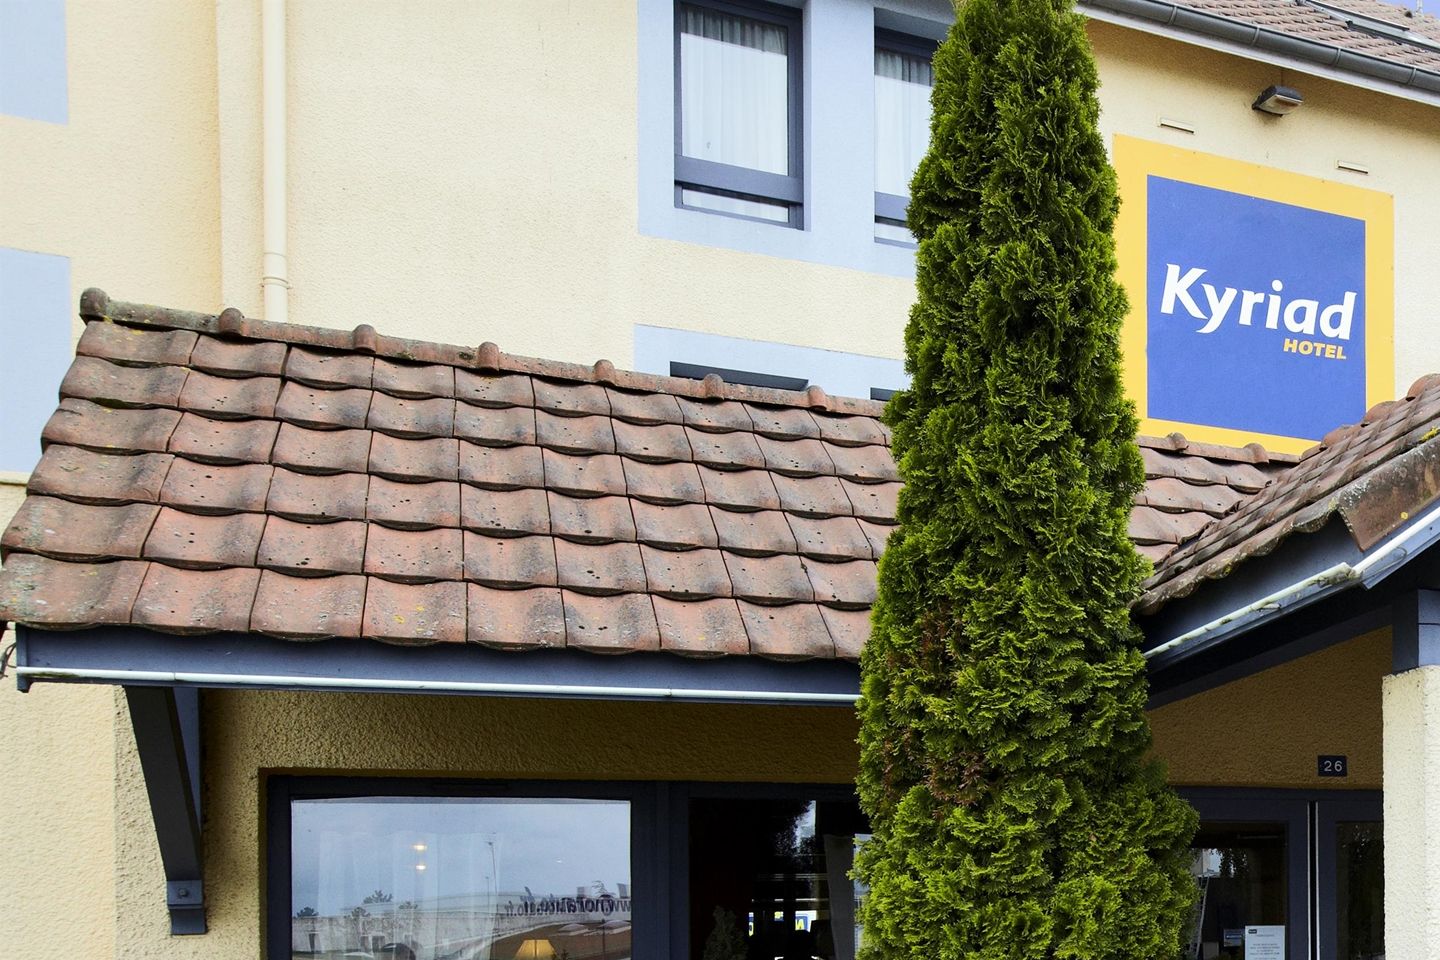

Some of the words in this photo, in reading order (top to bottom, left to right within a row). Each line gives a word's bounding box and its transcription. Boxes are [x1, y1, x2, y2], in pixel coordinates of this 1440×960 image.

[1160, 263, 1358, 341] Kyriad
[1283, 338, 1347, 361] HOTEL
[1324, 760, 1343, 772] 26
